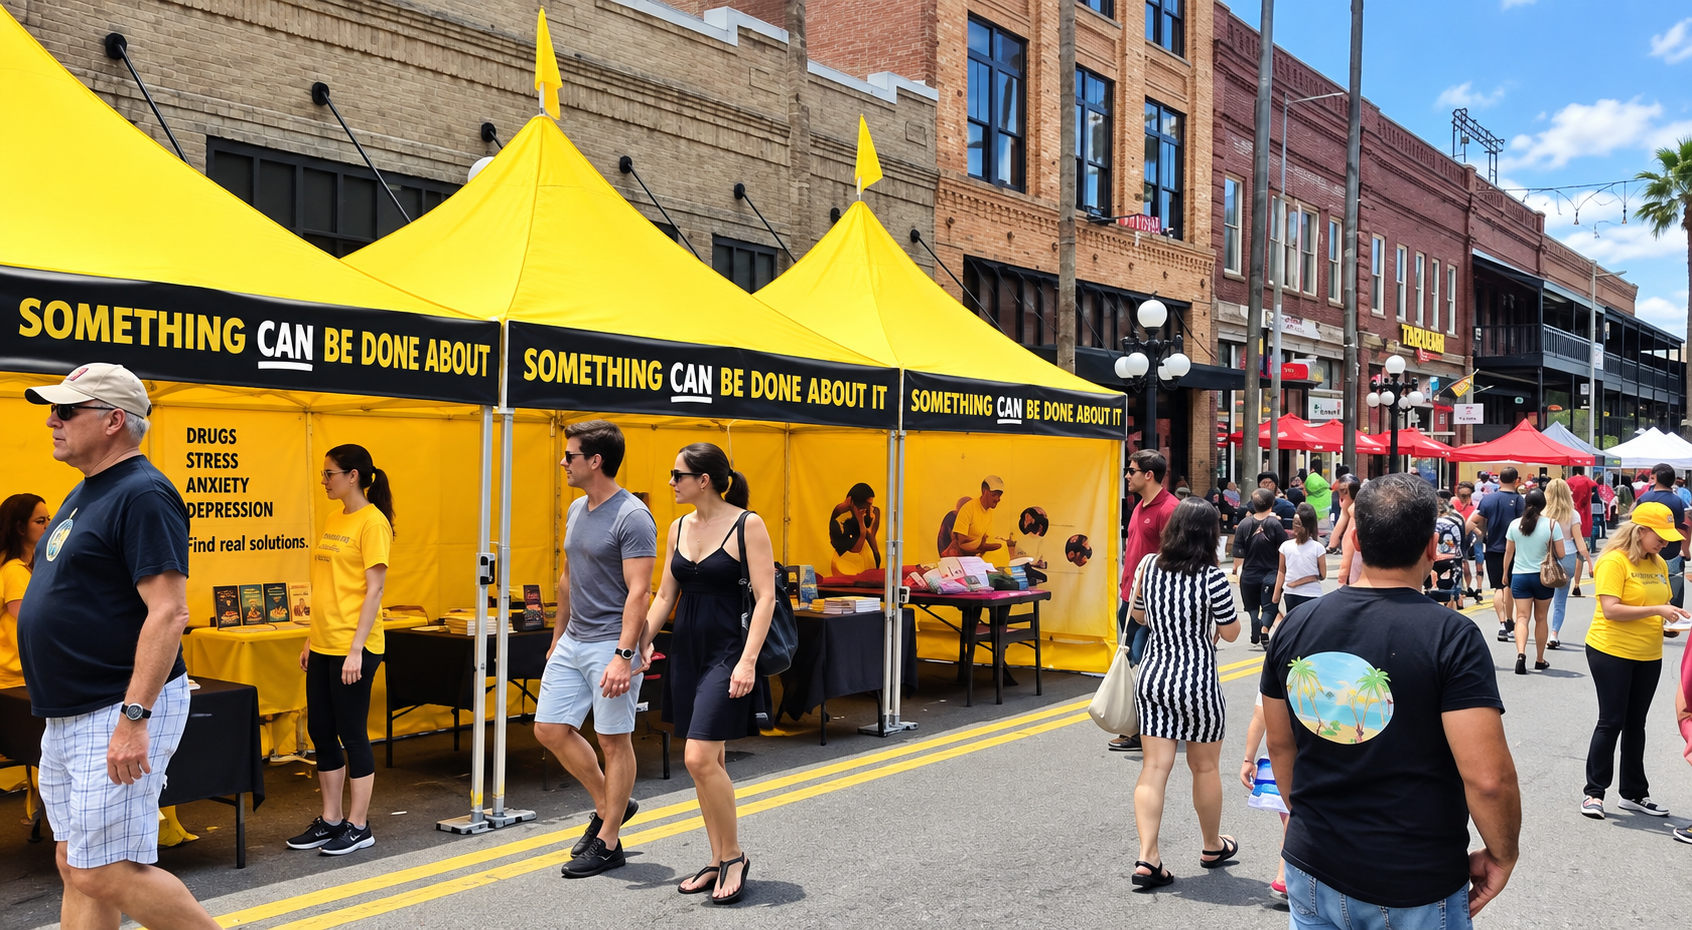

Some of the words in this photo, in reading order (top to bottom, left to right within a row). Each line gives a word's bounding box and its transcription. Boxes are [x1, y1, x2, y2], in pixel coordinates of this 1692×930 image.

[19, 297, 247, 354] SOMETHING
[257, 320, 314, 361] CAN
[324, 326, 354, 364] BE
[361, 330, 420, 371] DONE
[425, 338, 491, 377] ABOUT
[524, 347, 663, 391] SOMETHING
[670, 361, 713, 395] CAN
[720, 366, 744, 398] BE
[751, 370, 802, 403] DONE
[807, 377, 867, 409] ABOUT
[872, 384, 888, 410] IT
[911, 388, 993, 417] SOMETHING
[997, 396, 1023, 419] CAN
[1026, 399, 1040, 420] BE
[1044, 401, 1074, 423] DONE
[1076, 405, 1110, 426] ABOUT
[1112, 408, 1123, 426] IT
[186, 427, 237, 445] DRUGS
[186, 452, 239, 469] STRESS
[186, 477, 250, 493] ANXIETY
[187, 501, 273, 519] DEPRESSION
[220, 535, 246, 551] real
[250, 534, 309, 551] solutions.
